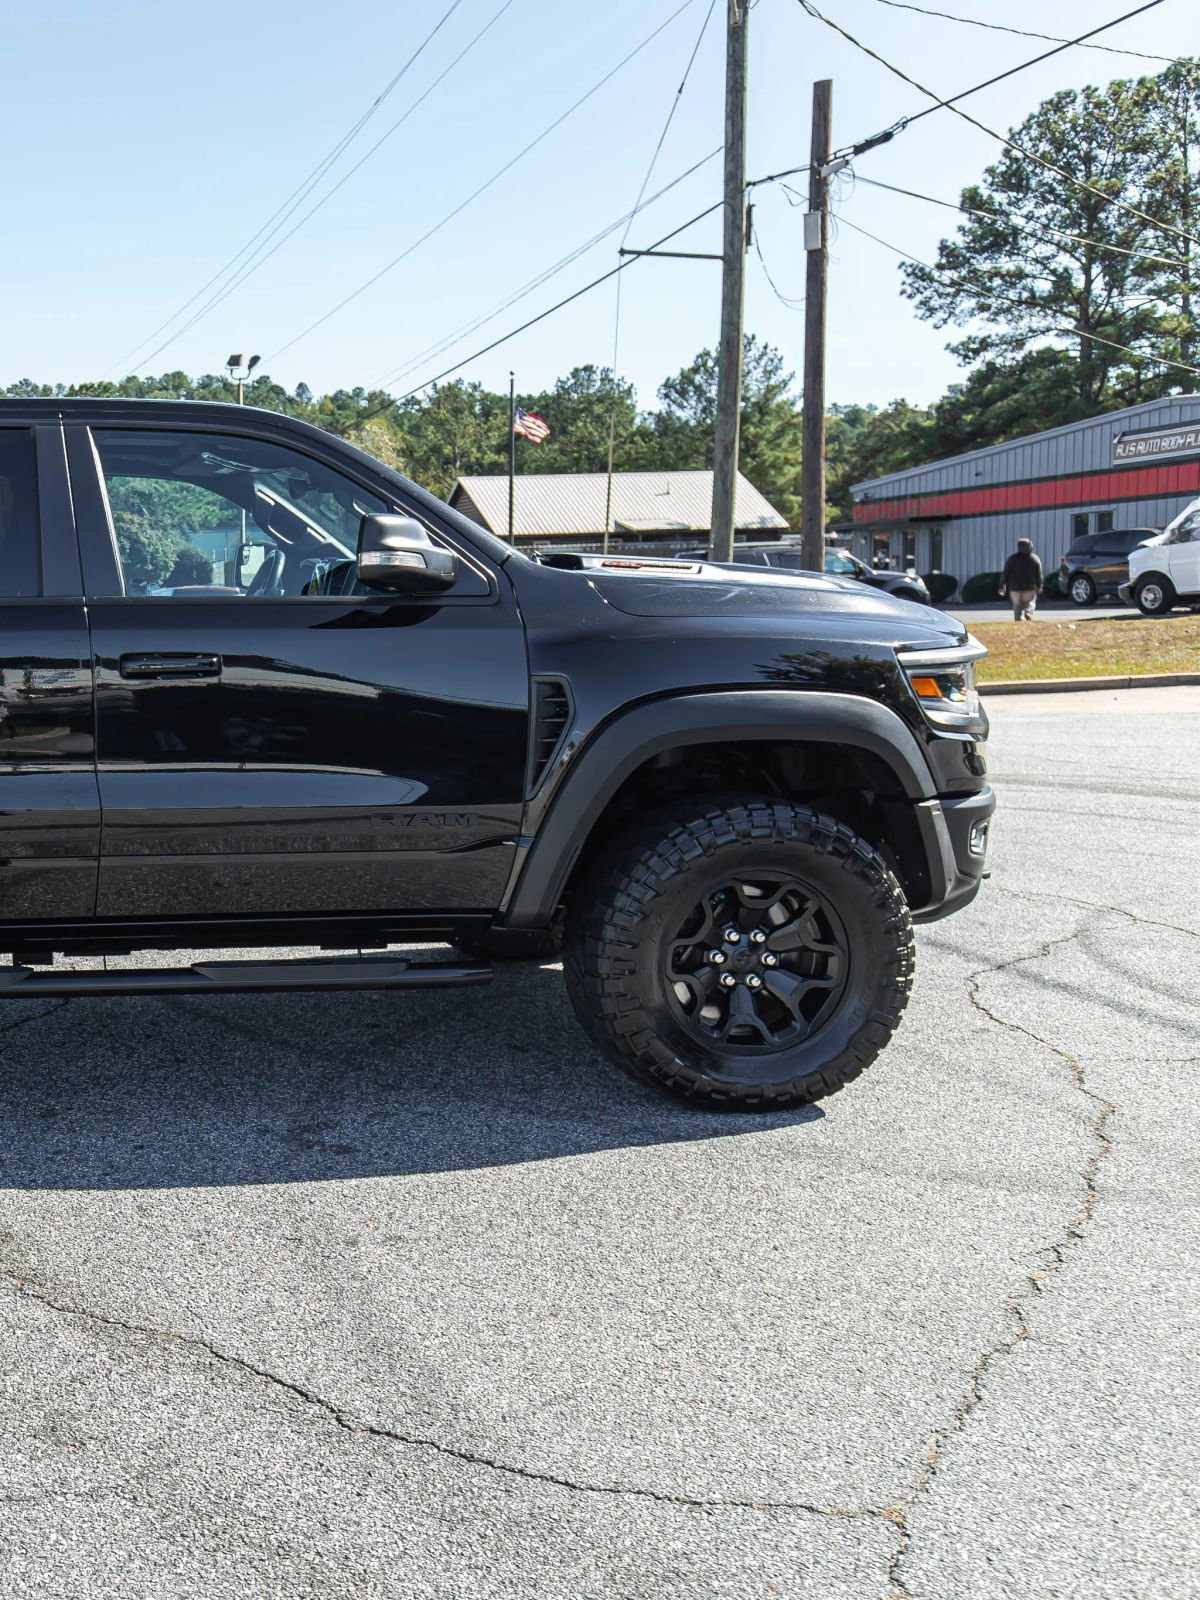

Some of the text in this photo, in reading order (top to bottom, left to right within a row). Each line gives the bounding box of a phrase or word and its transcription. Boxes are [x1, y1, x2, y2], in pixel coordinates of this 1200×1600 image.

[1136, 439, 1160, 453] AUTO
[1161, 434, 1185, 450] BODY
[369, 812, 480, 827] RAM
